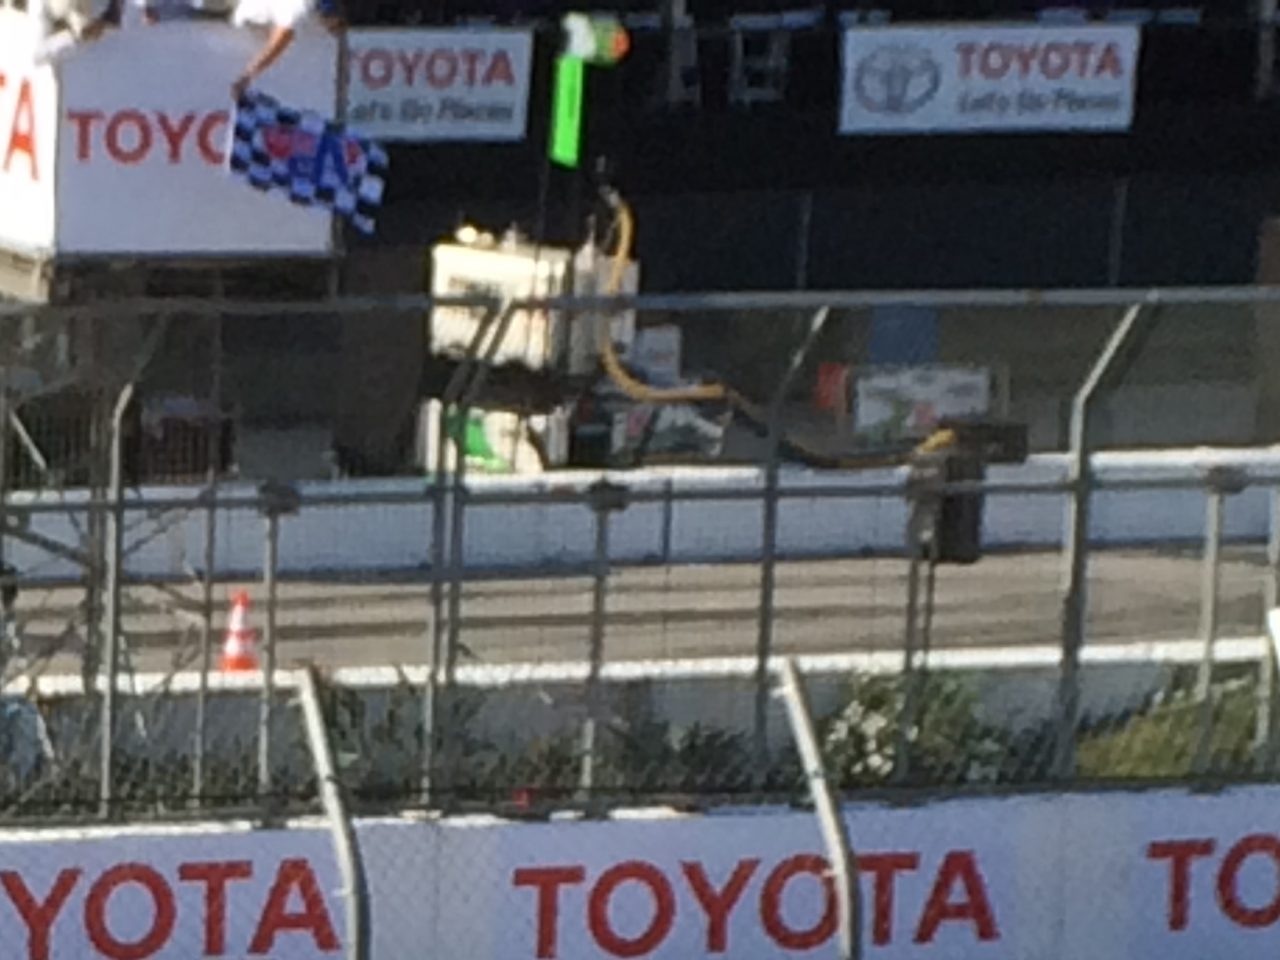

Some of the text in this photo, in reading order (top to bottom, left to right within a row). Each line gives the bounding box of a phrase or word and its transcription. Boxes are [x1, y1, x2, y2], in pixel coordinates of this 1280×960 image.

[349, 49, 516, 91] OYOTA
[955, 41, 1123, 81] TOYOTA
[513, 849, 999, 960] TOYOTA
